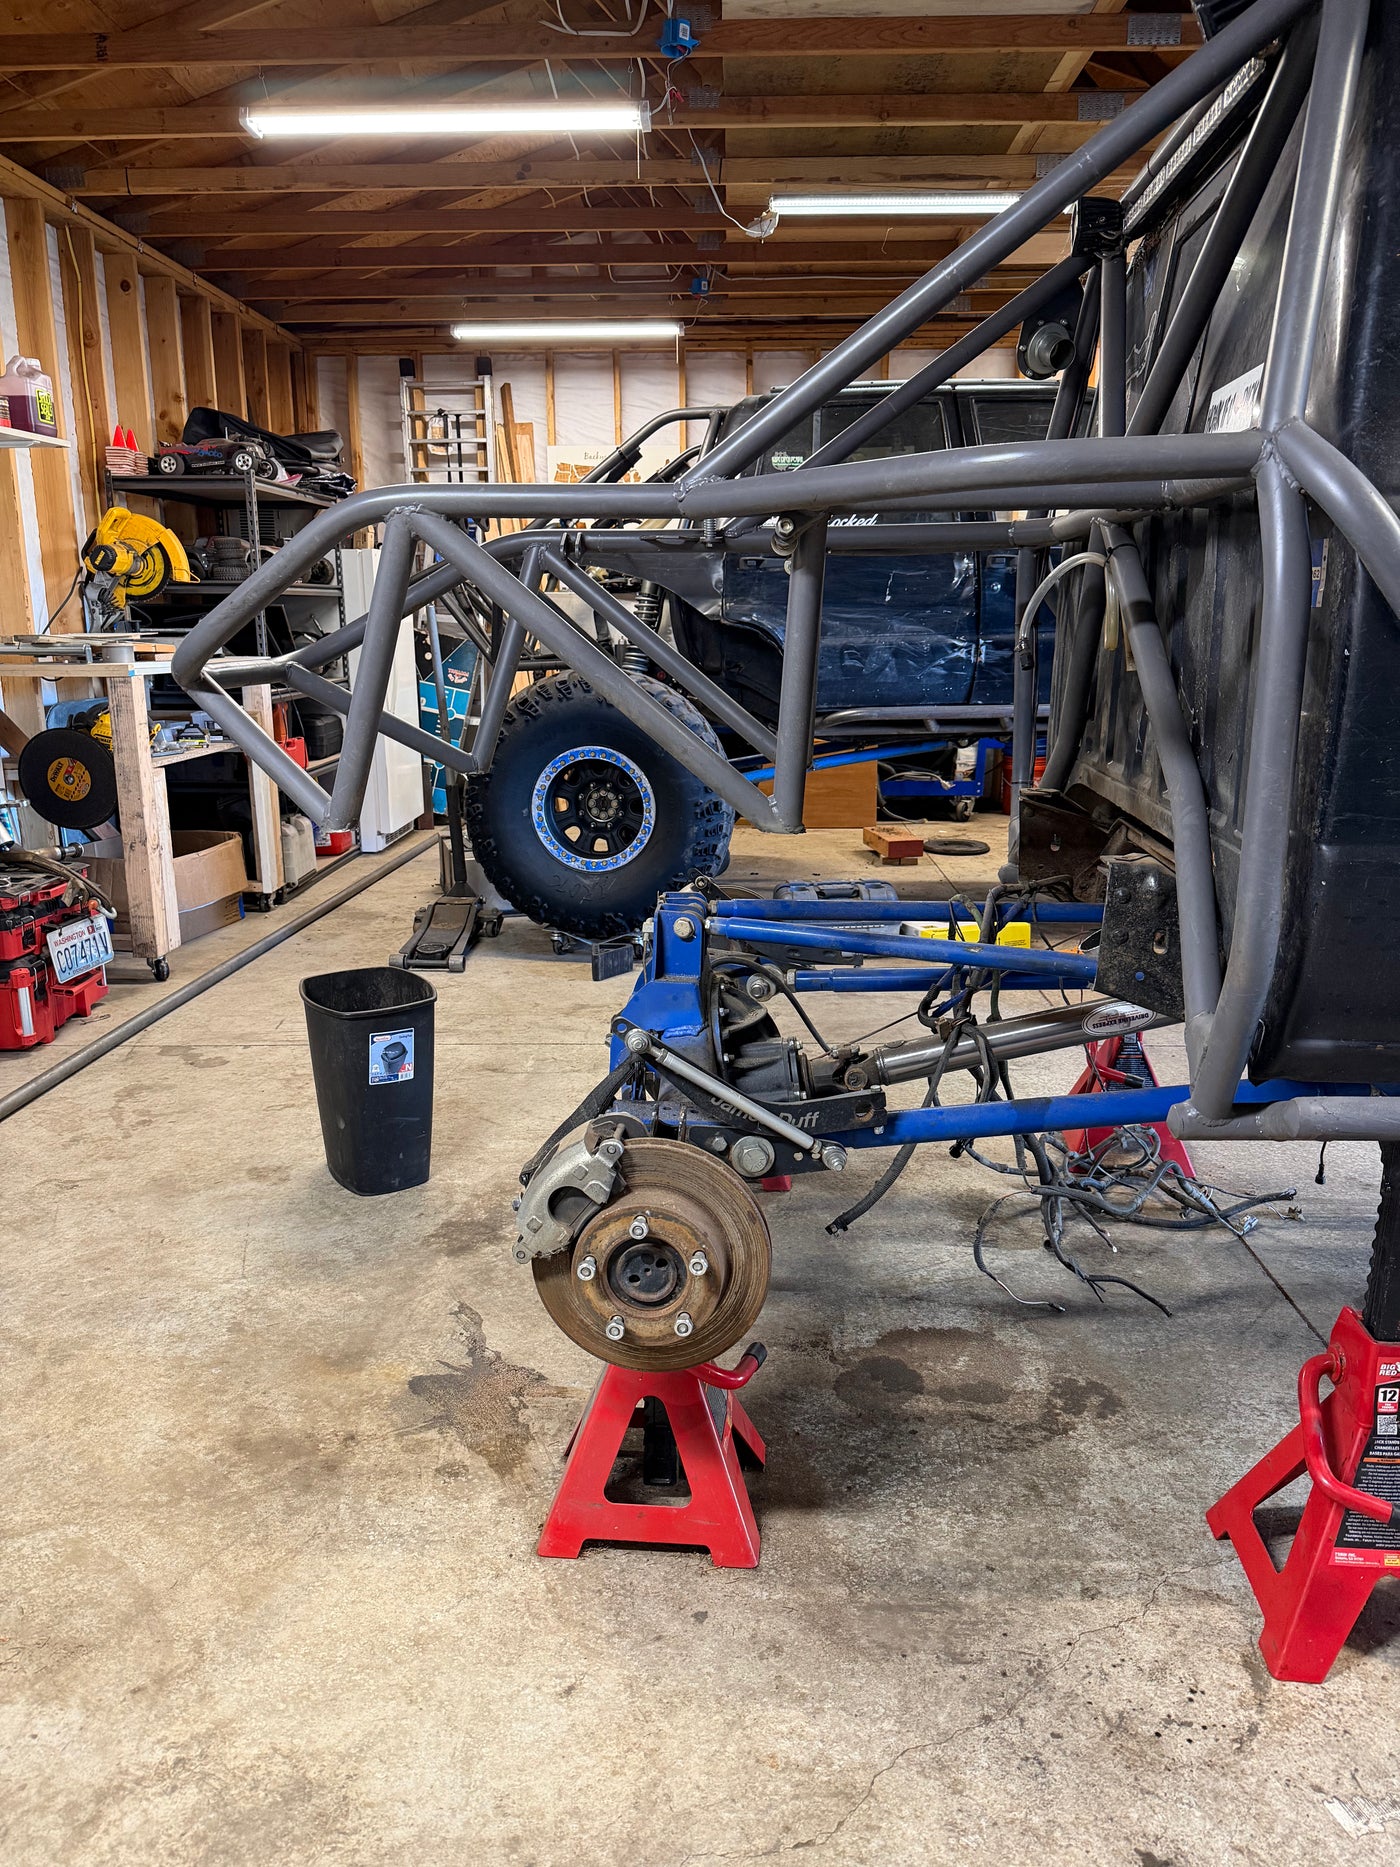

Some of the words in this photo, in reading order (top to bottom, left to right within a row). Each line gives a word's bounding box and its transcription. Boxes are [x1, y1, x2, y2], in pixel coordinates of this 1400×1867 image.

[53, 930, 86, 947] WASHINGTON
[1092, 1020, 1117, 1030] EXPRESS
[1380, 1389, 1398, 1402] 12
